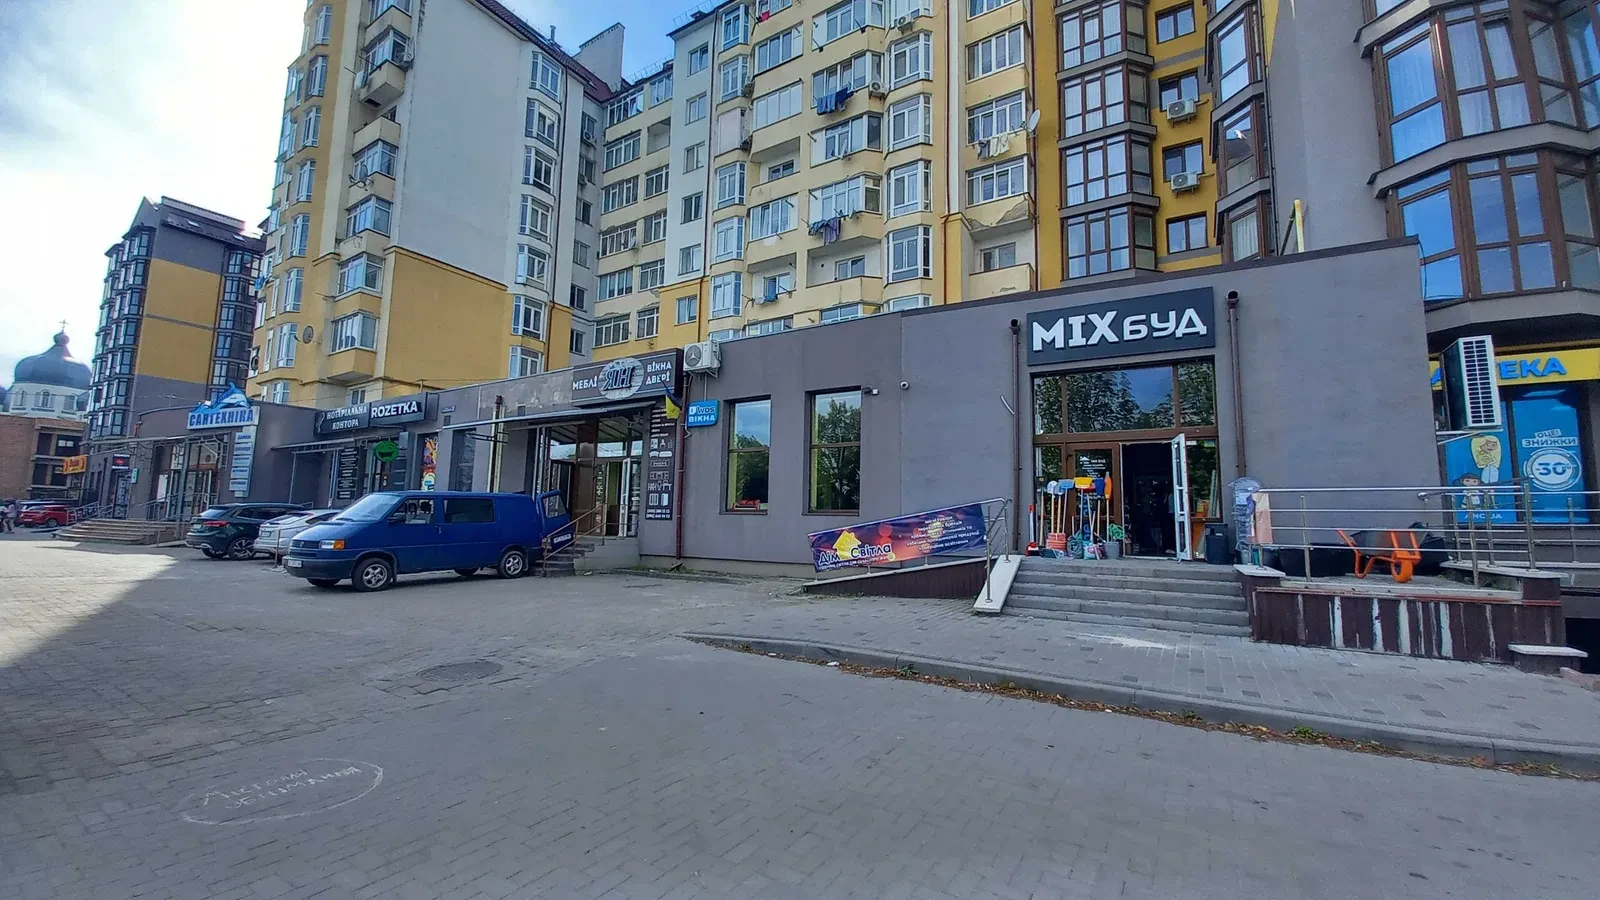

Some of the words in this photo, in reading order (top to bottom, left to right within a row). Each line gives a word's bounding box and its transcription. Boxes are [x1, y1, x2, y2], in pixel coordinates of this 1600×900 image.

[647, 361, 672, 373] ВІКНА
[572, 375, 598, 391] МЕБЛІ
[645, 371, 670, 386] ДВЕРІ
[371, 401, 418, 419] ROZETKA
[189, 409, 254, 427] САНТЕХНІКА
[331, 418, 359, 431] КОНТОРА
[688, 415, 716, 423] ВІКНА
[1524, 439, 1576, 447] ЗНИЖКИ
[818, 550, 841, 566] Дім
[849, 543, 892, 559] Світла
